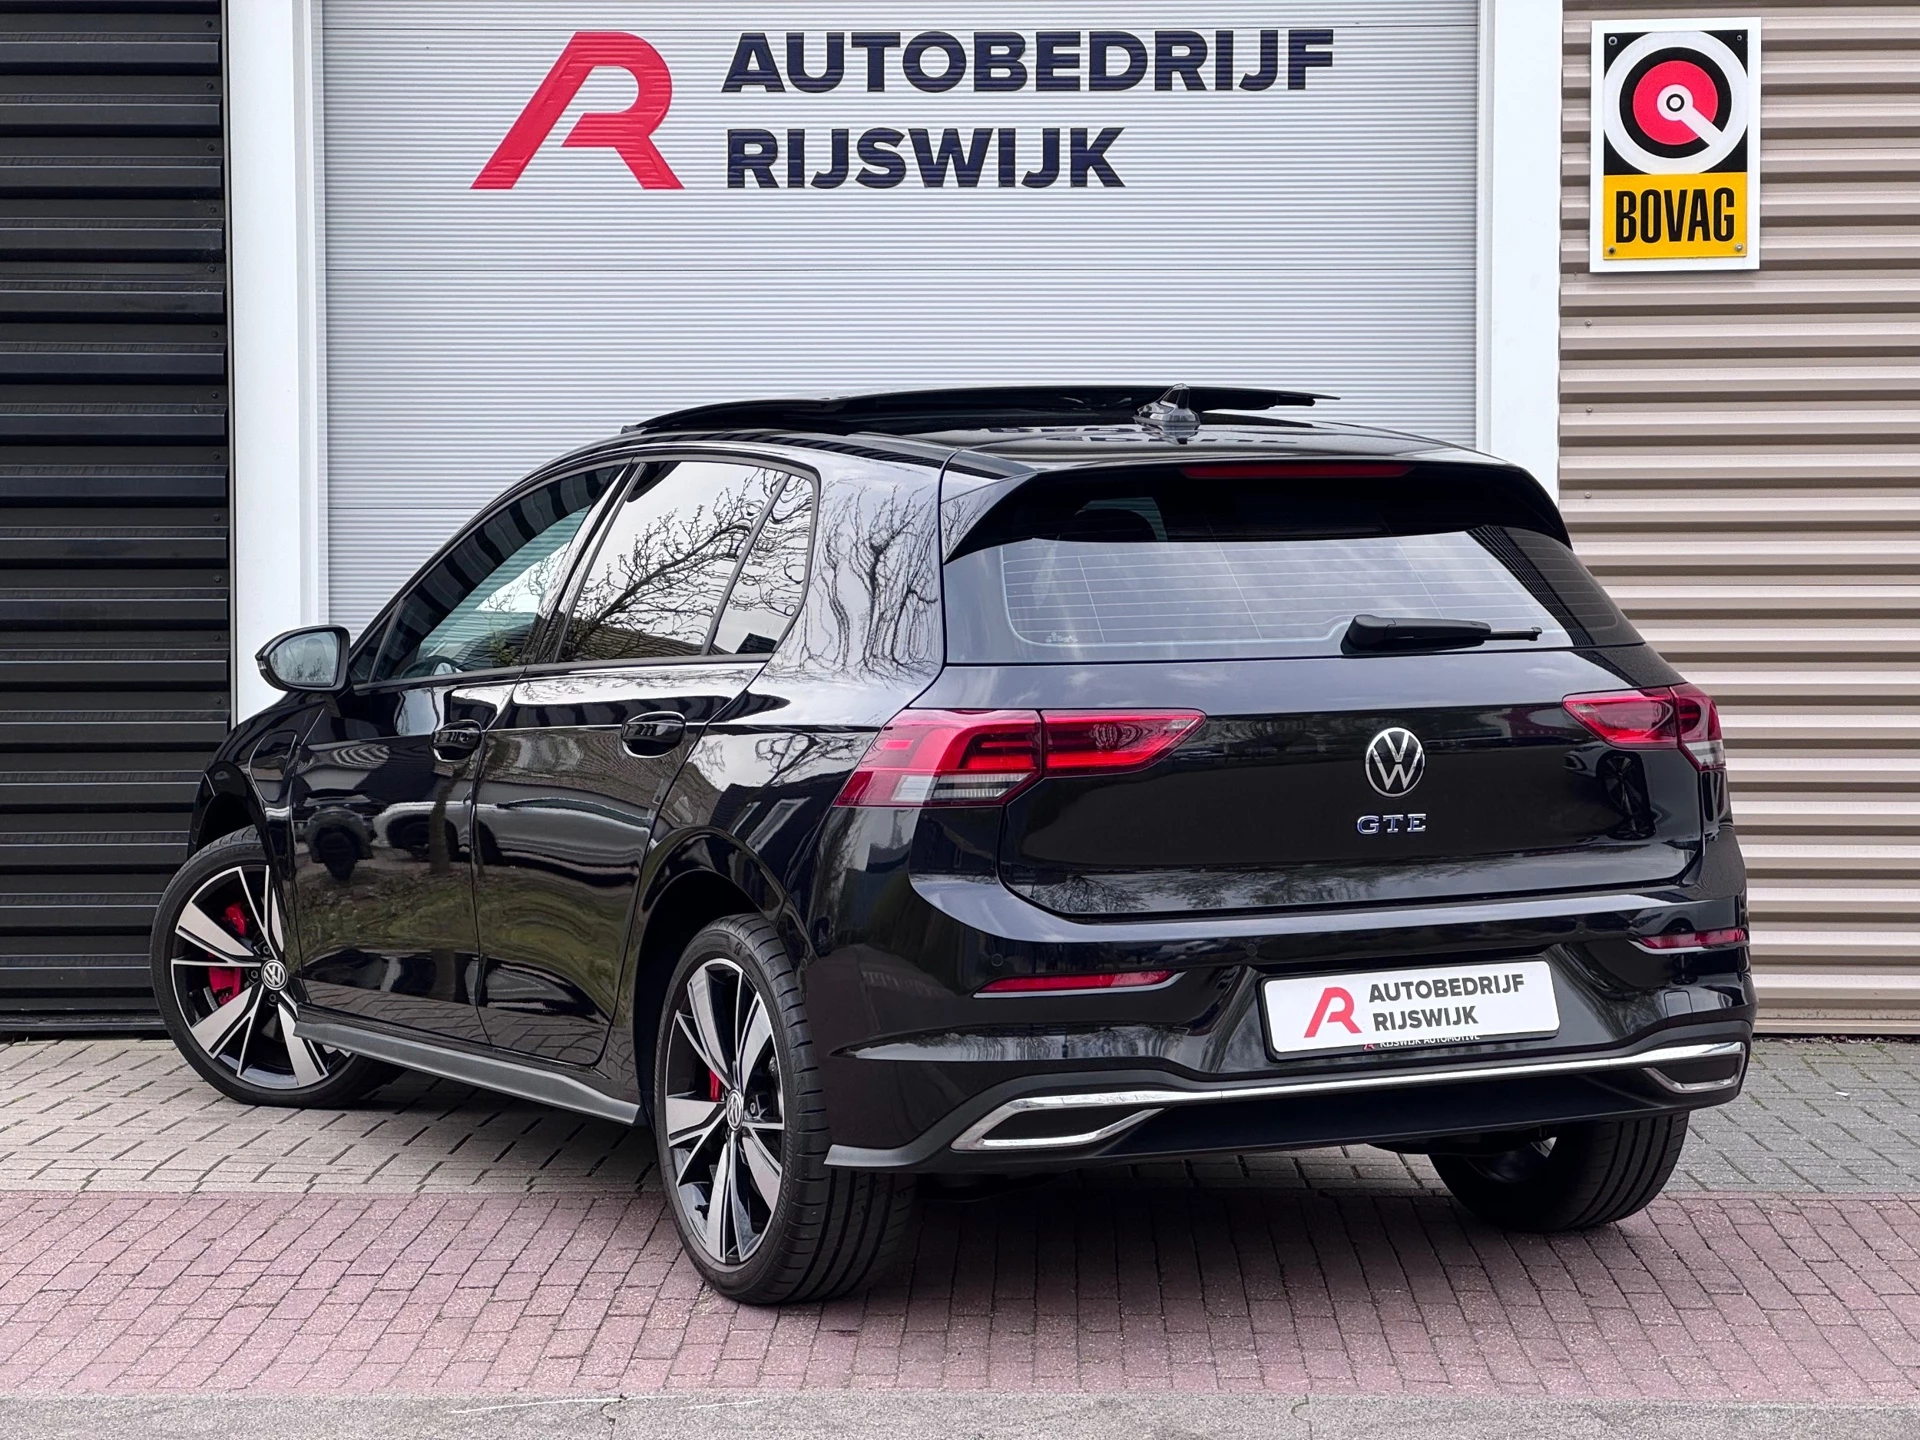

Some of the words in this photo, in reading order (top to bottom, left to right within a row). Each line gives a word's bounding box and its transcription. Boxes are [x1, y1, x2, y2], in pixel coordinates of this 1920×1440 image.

[722, 29, 1334, 93] AUTOBEDRIJF
[727, 127, 1126, 189] RIJSWIJK
[1615, 187, 1735, 243] BOVAG
[1356, 813, 1427, 835] GTE
[1368, 973, 1525, 1003] AUTOBEDRIJF
[1372, 1005, 1479, 1032] RIJSWIJK
